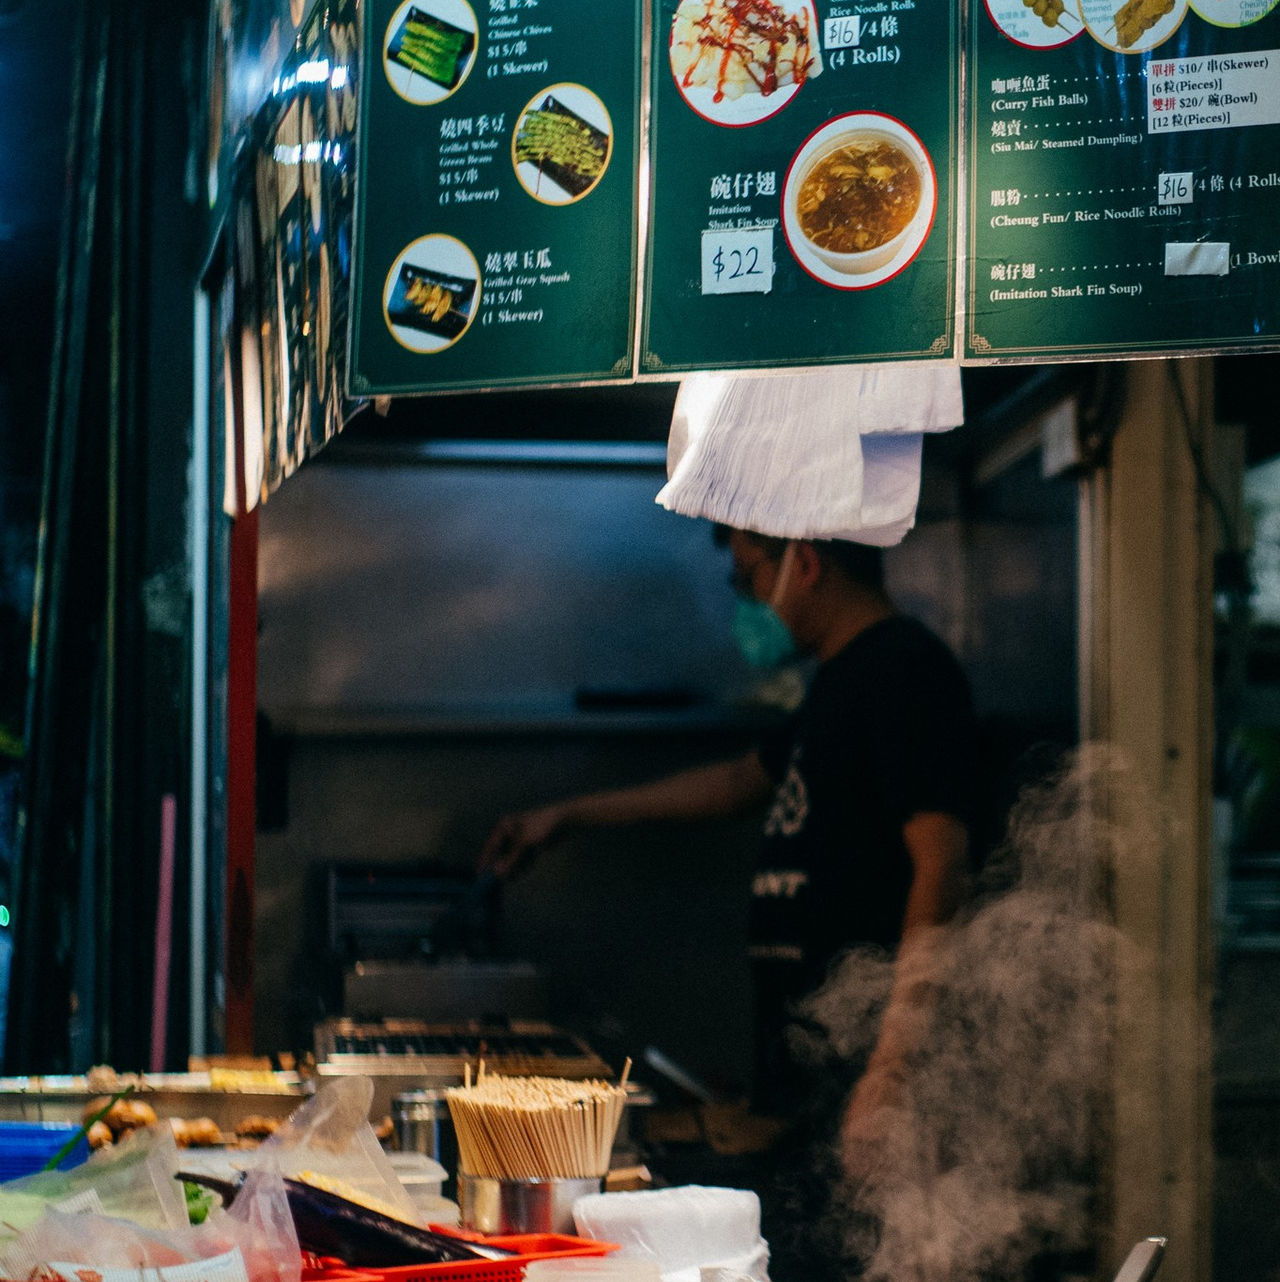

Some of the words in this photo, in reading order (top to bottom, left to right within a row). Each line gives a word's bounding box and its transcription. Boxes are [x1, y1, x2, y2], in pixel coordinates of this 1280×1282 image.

[829, 5, 851, 18] Rice
[854, 2, 888, 15] Noodle
[891, 0, 916, 11] Rolls
[828, 20, 855, 45] $16
[829, 50, 845, 70] (4
[852, 45, 900, 66] Rolls)
[503, 59, 549, 77] Skewer)
[991, 98, 1028, 113] (Curry
[1032, 95, 1055, 108] Fish
[1058, 93, 1088, 107] Balls)
[990, 143, 1011, 154] (Siu
[1014, 139, 1039, 152] Mai/
[1042, 136, 1085, 149] Steamed
[709, 171, 777, 200] 碗仔翅
[1160, 178, 1189, 200] $16
[454, 187, 500, 204] Skewer)
[990, 189, 1021, 207] 腸粉
[708, 204, 751, 215] Imitation
[990, 214, 1039, 229] (Cheung
[1043, 211, 1070, 224] Fun/
[1075, 209, 1100, 222] Rice
[1104, 206, 1145, 219] Noodle
[1148, 205, 1182, 218] Rolls)
[708, 218, 734, 230] Shark
[737, 217, 752, 227] Fin
[755, 217, 779, 228] Soup
[712, 245, 763, 282] $22
[990, 262, 1036, 281] 碗仔翅
[990, 285, 1048, 302] (Imitation
[1051, 283, 1083, 297] Shark
[1087, 282, 1106, 296] Fin
[1109, 280, 1143, 295] Soup)
[498, 307, 544, 325] Skewer)
